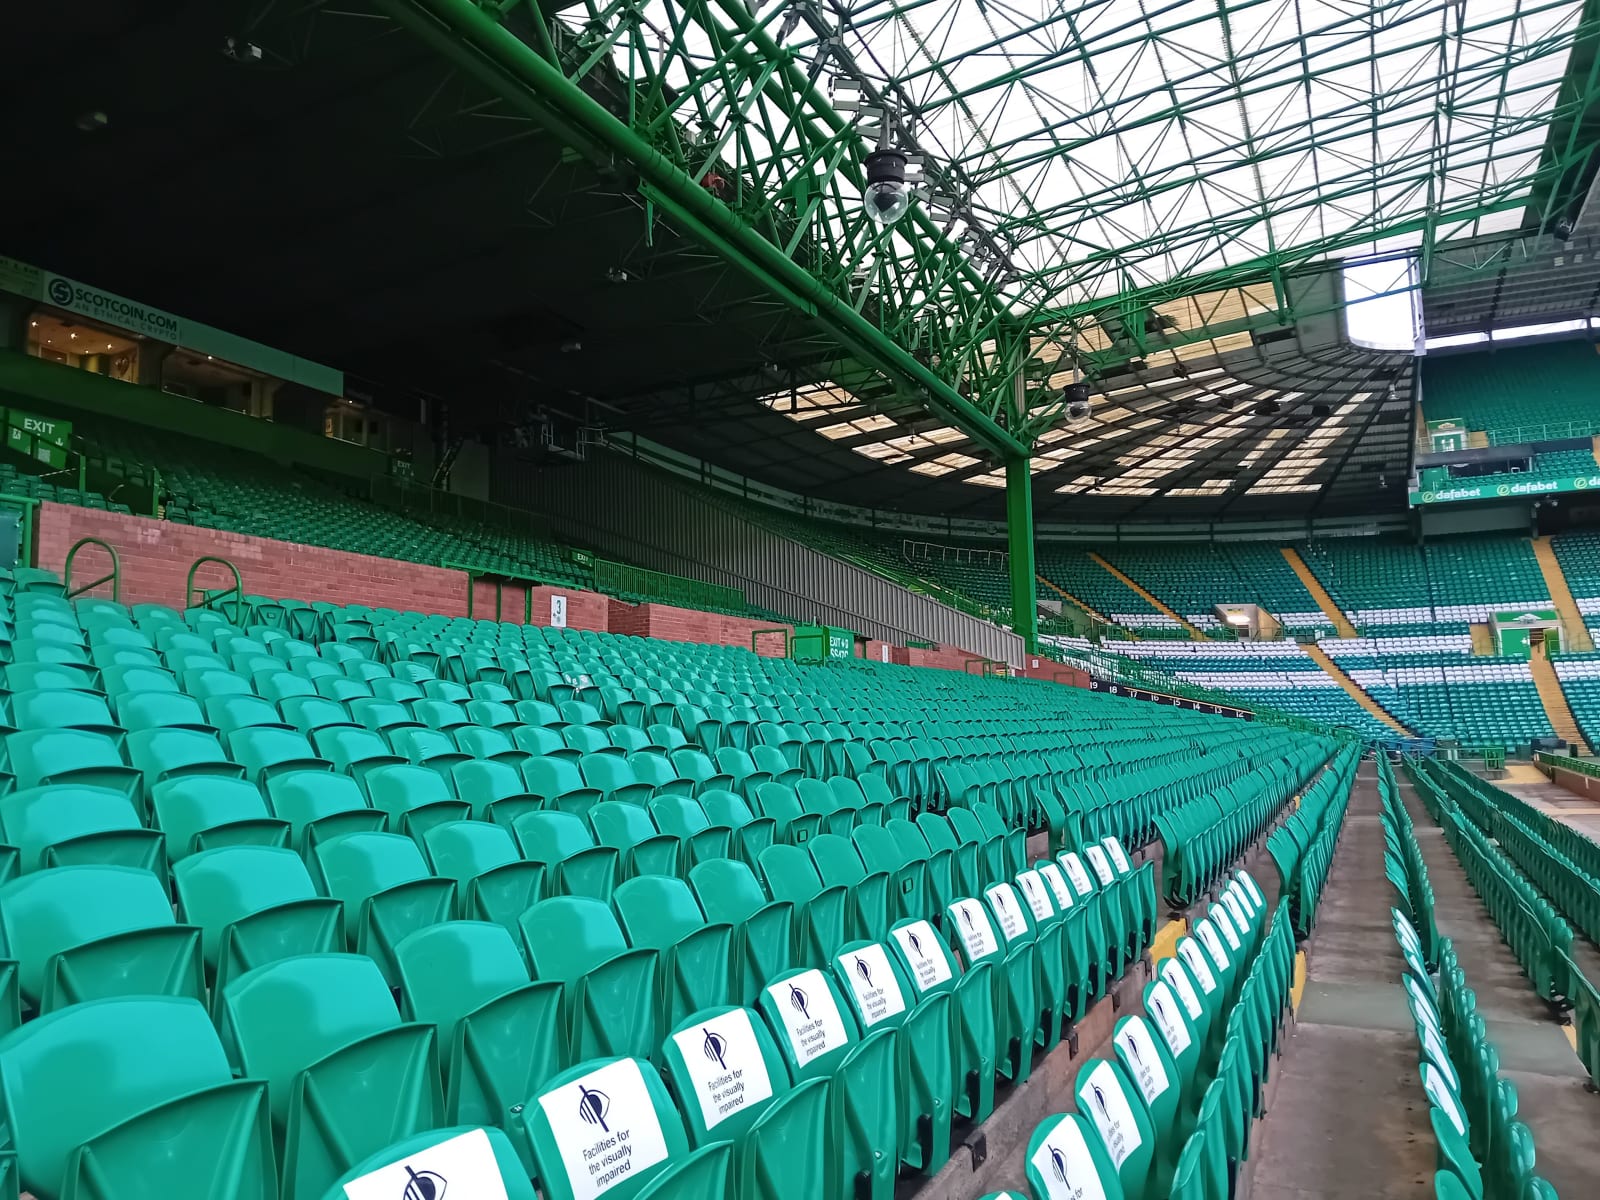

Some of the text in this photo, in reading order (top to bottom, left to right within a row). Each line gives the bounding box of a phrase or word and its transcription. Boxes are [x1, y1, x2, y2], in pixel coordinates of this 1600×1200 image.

[75, 288, 177, 331] SCOTCOIN.COM
[94, 307, 136, 327] ETHICAL
[23, 417, 55, 434] EXIT
[1435, 487, 1481, 500] dafabet
[1510, 481, 1558, 493] dafabet
[556, 599, 562, 614] 3
[1130, 690, 1137, 698] 17
[708, 1069, 742, 1091] Facilities for
[722, 1081, 744, 1098] visually
[719, 1094, 744, 1114] impaired
[582, 1129, 630, 1161] Facilities for
[589, 1144, 631, 1175] the visually
[597, 1158, 631, 1187] impaired
